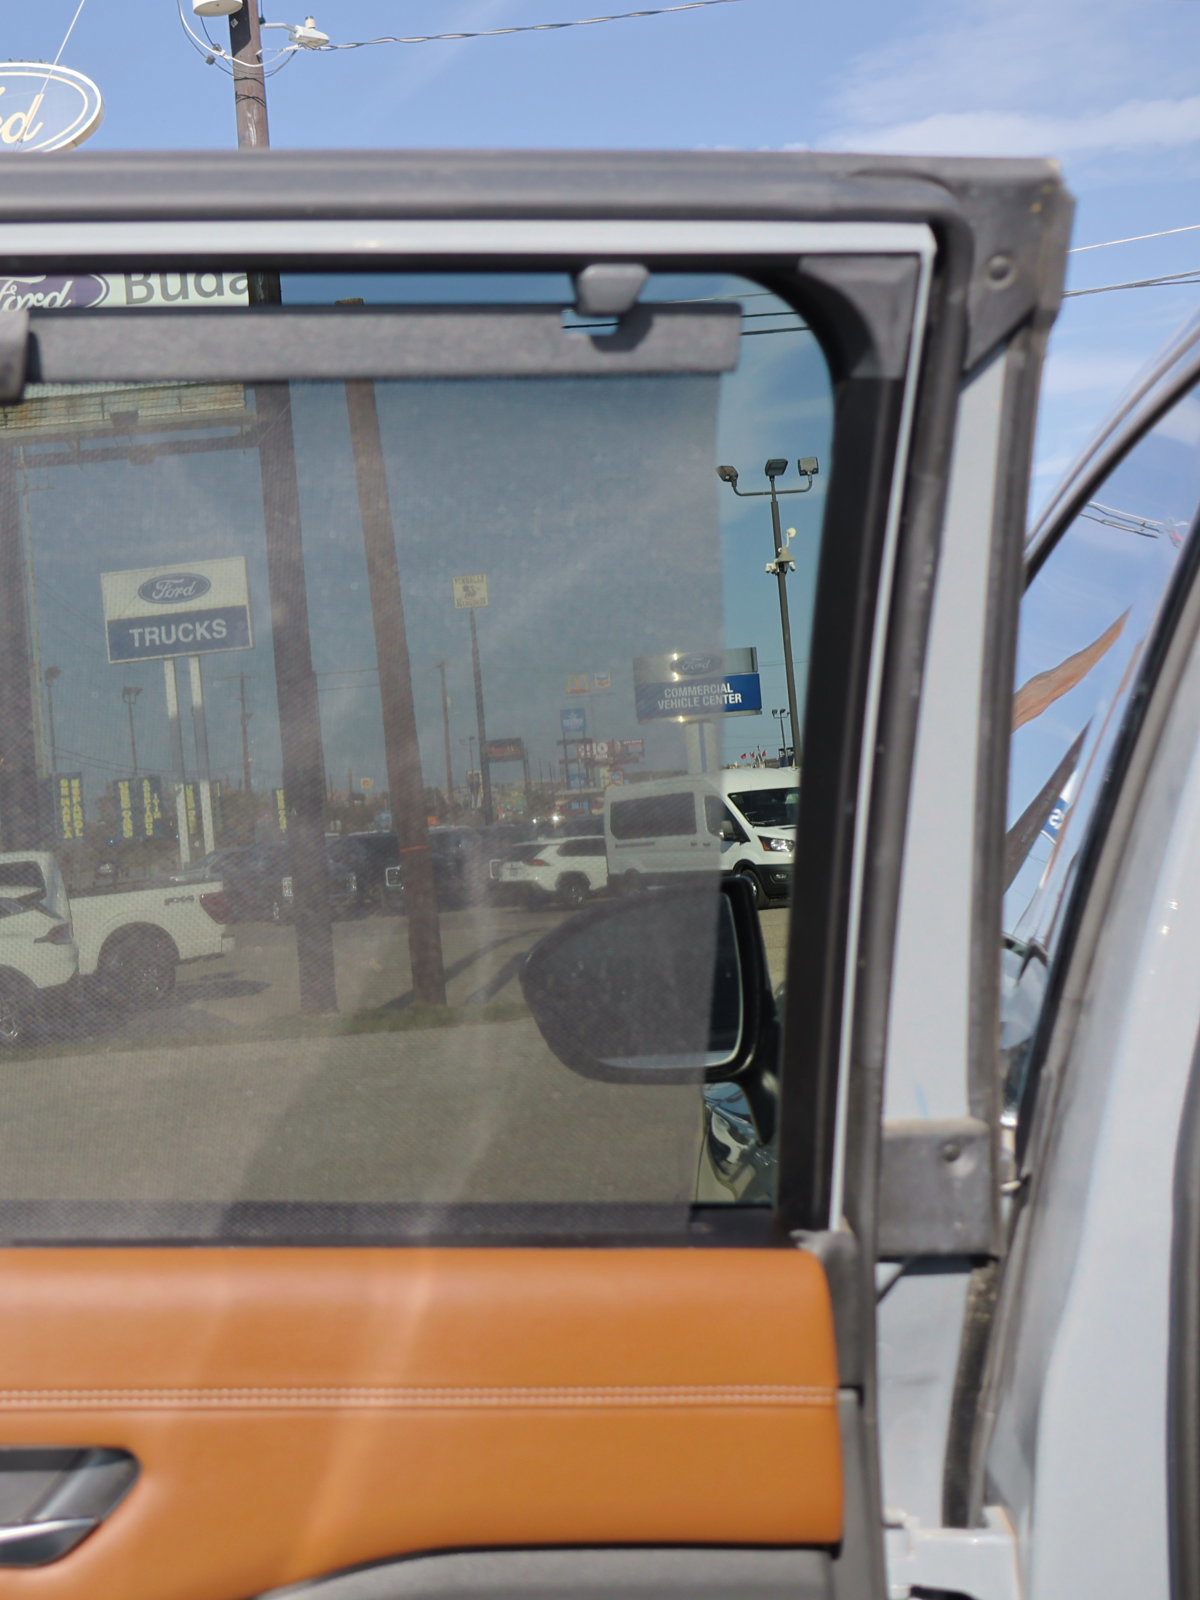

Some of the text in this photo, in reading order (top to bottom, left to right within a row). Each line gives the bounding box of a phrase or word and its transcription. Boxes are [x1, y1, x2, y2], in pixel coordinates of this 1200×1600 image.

[152, 578, 197, 600] Ford
[129, 618, 228, 648] TRUCKS
[681, 657, 711, 671] Ford
[664, 682, 734, 698] COMMERCIAL
[657, 693, 742, 710] VEHICLE CENTER
